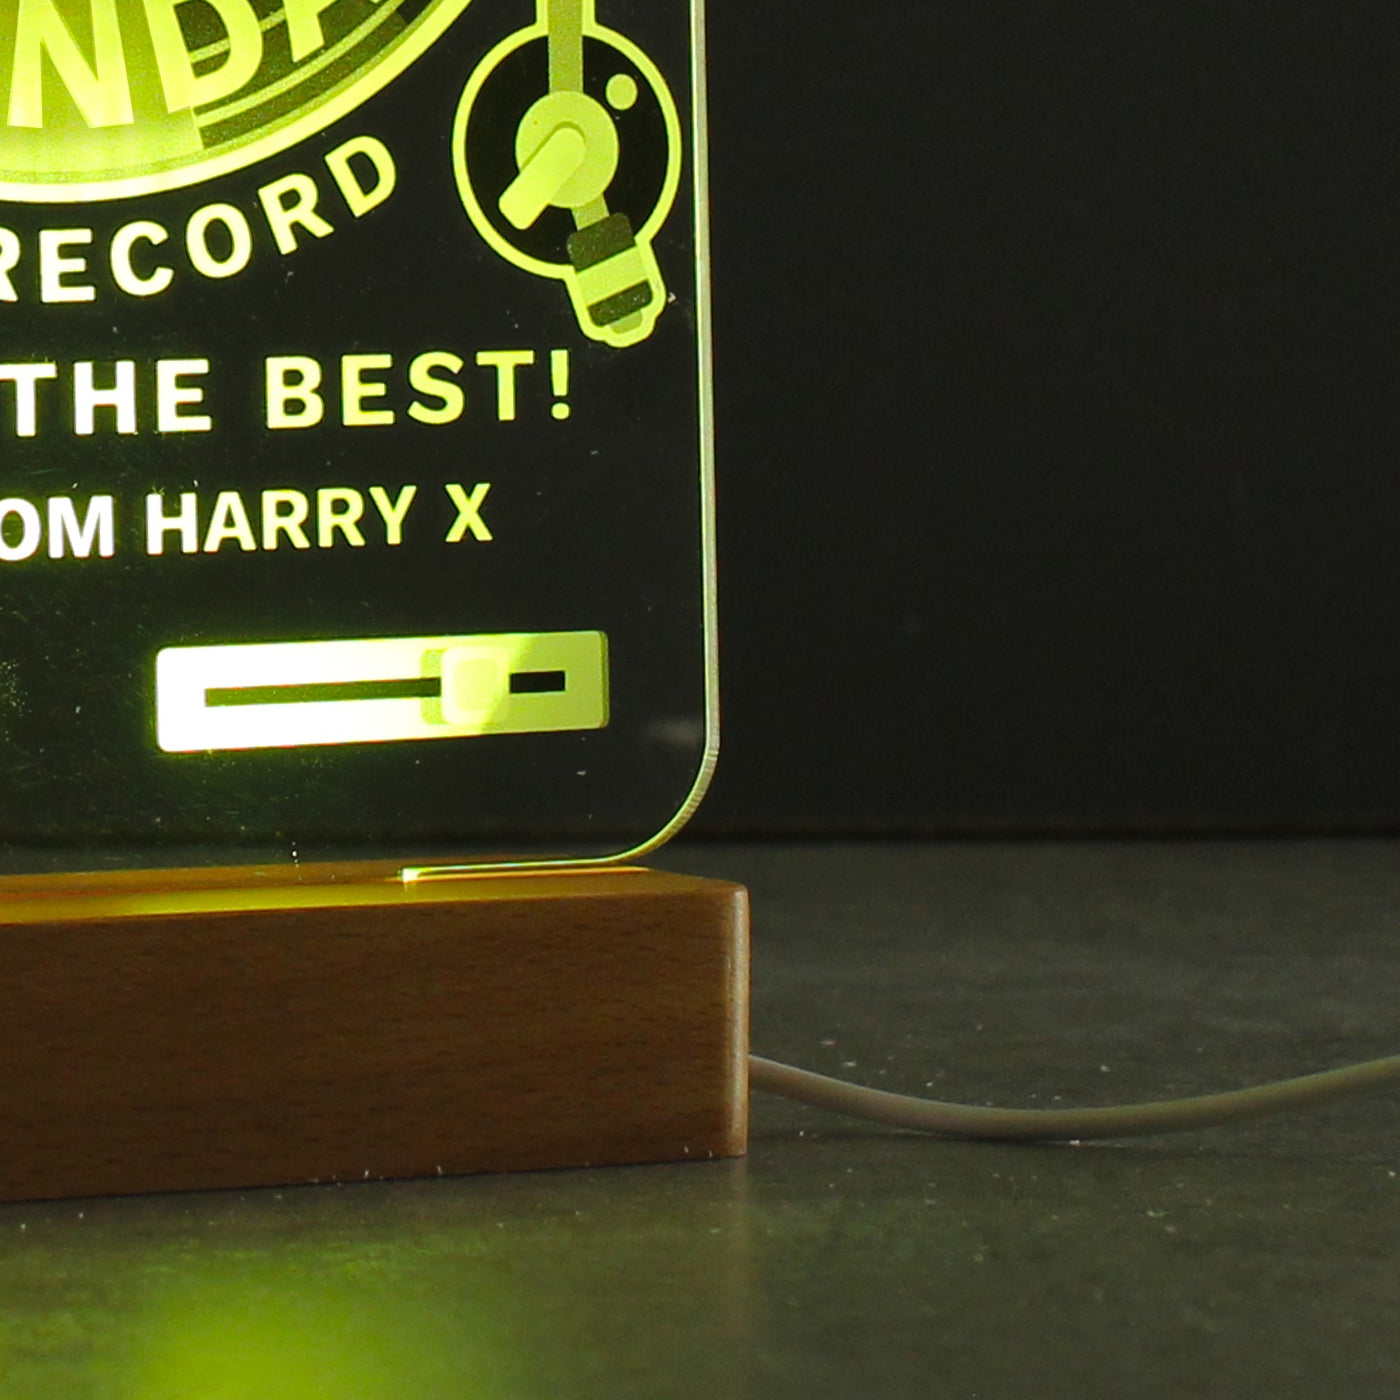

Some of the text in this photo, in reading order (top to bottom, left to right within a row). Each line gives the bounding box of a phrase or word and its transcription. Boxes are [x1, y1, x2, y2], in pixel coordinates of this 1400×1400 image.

[264, 349, 572, 430] BEST!
[145, 484, 418, 560] HARRY
[444, 481, 493, 544] X
